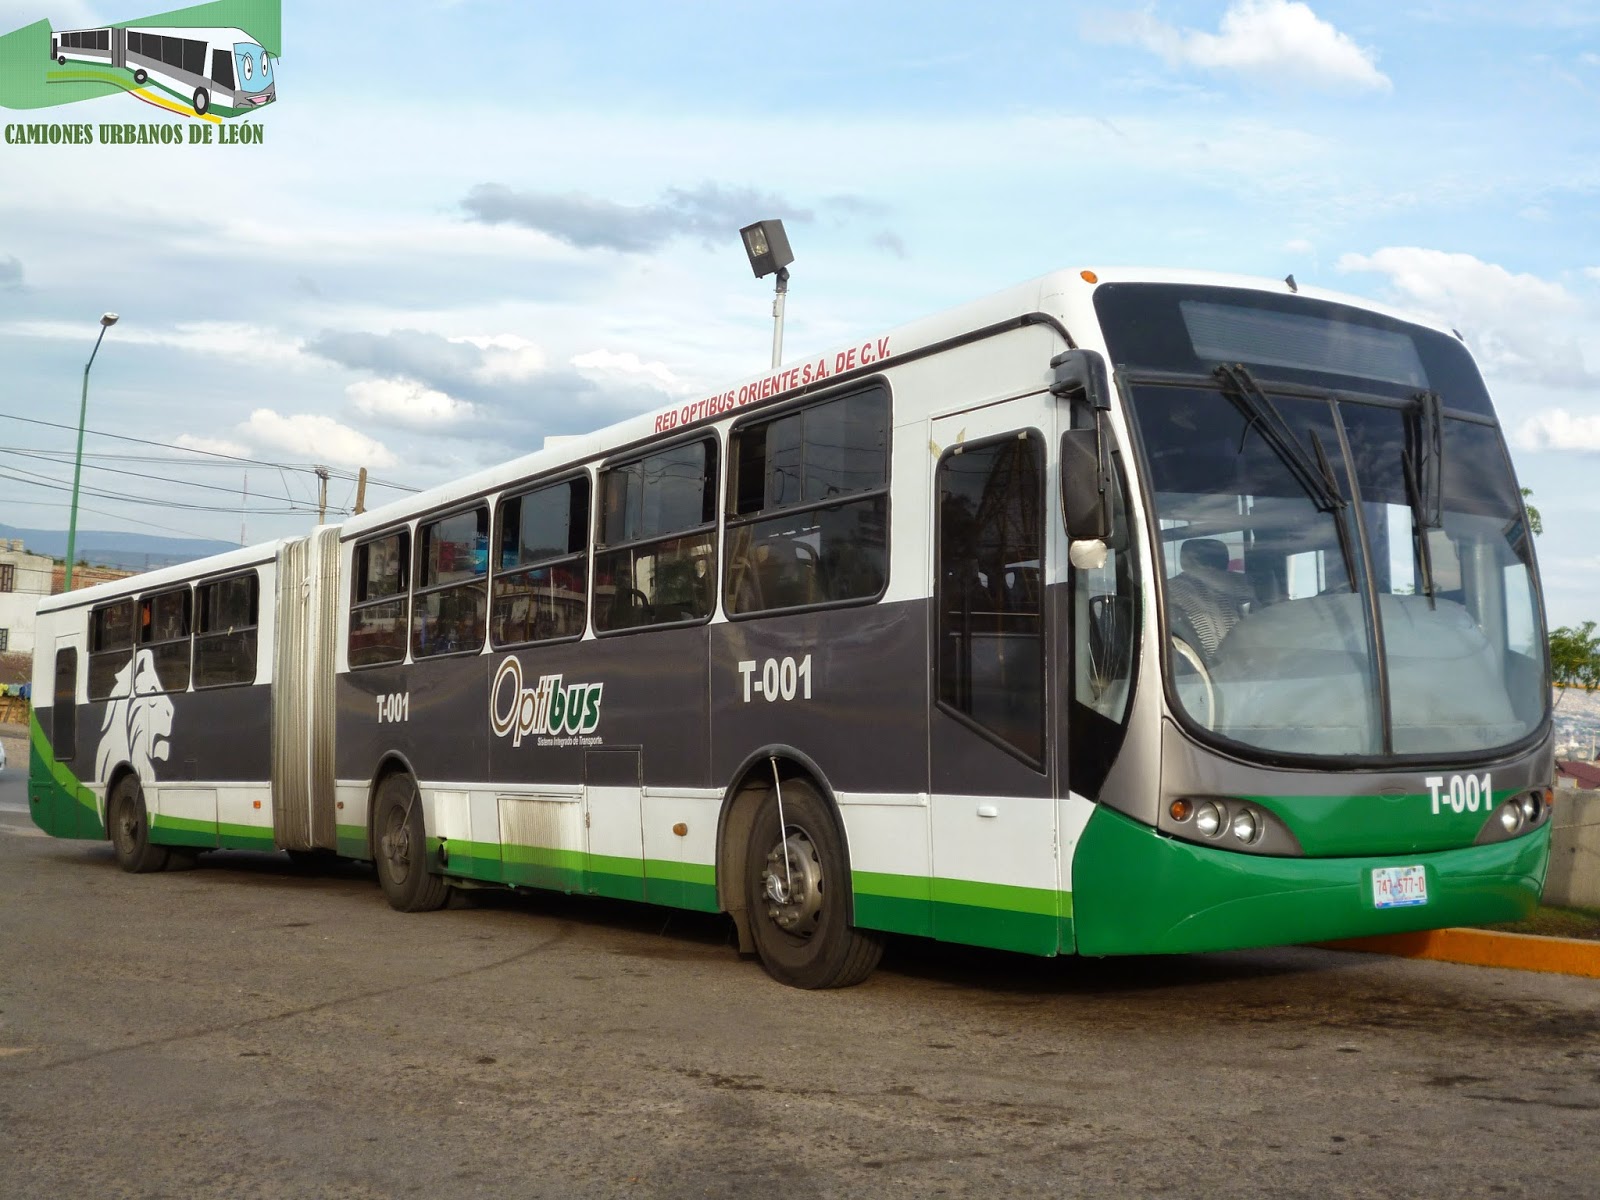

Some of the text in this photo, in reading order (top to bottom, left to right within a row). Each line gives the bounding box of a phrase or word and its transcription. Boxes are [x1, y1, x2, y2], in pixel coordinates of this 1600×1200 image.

[654, 336, 891, 434] RED OPTIBUS ORIENTE S.A. DE C.V.
[738, 654, 812, 703] T-001
[376, 691, 410, 724] T-001
[490, 655, 604, 748] Optibus
[537, 736, 553, 746] Sistema
[554, 736, 572, 748] Integrado
[573, 736, 579, 746] de
[1425, 773, 1493, 815] T-001
